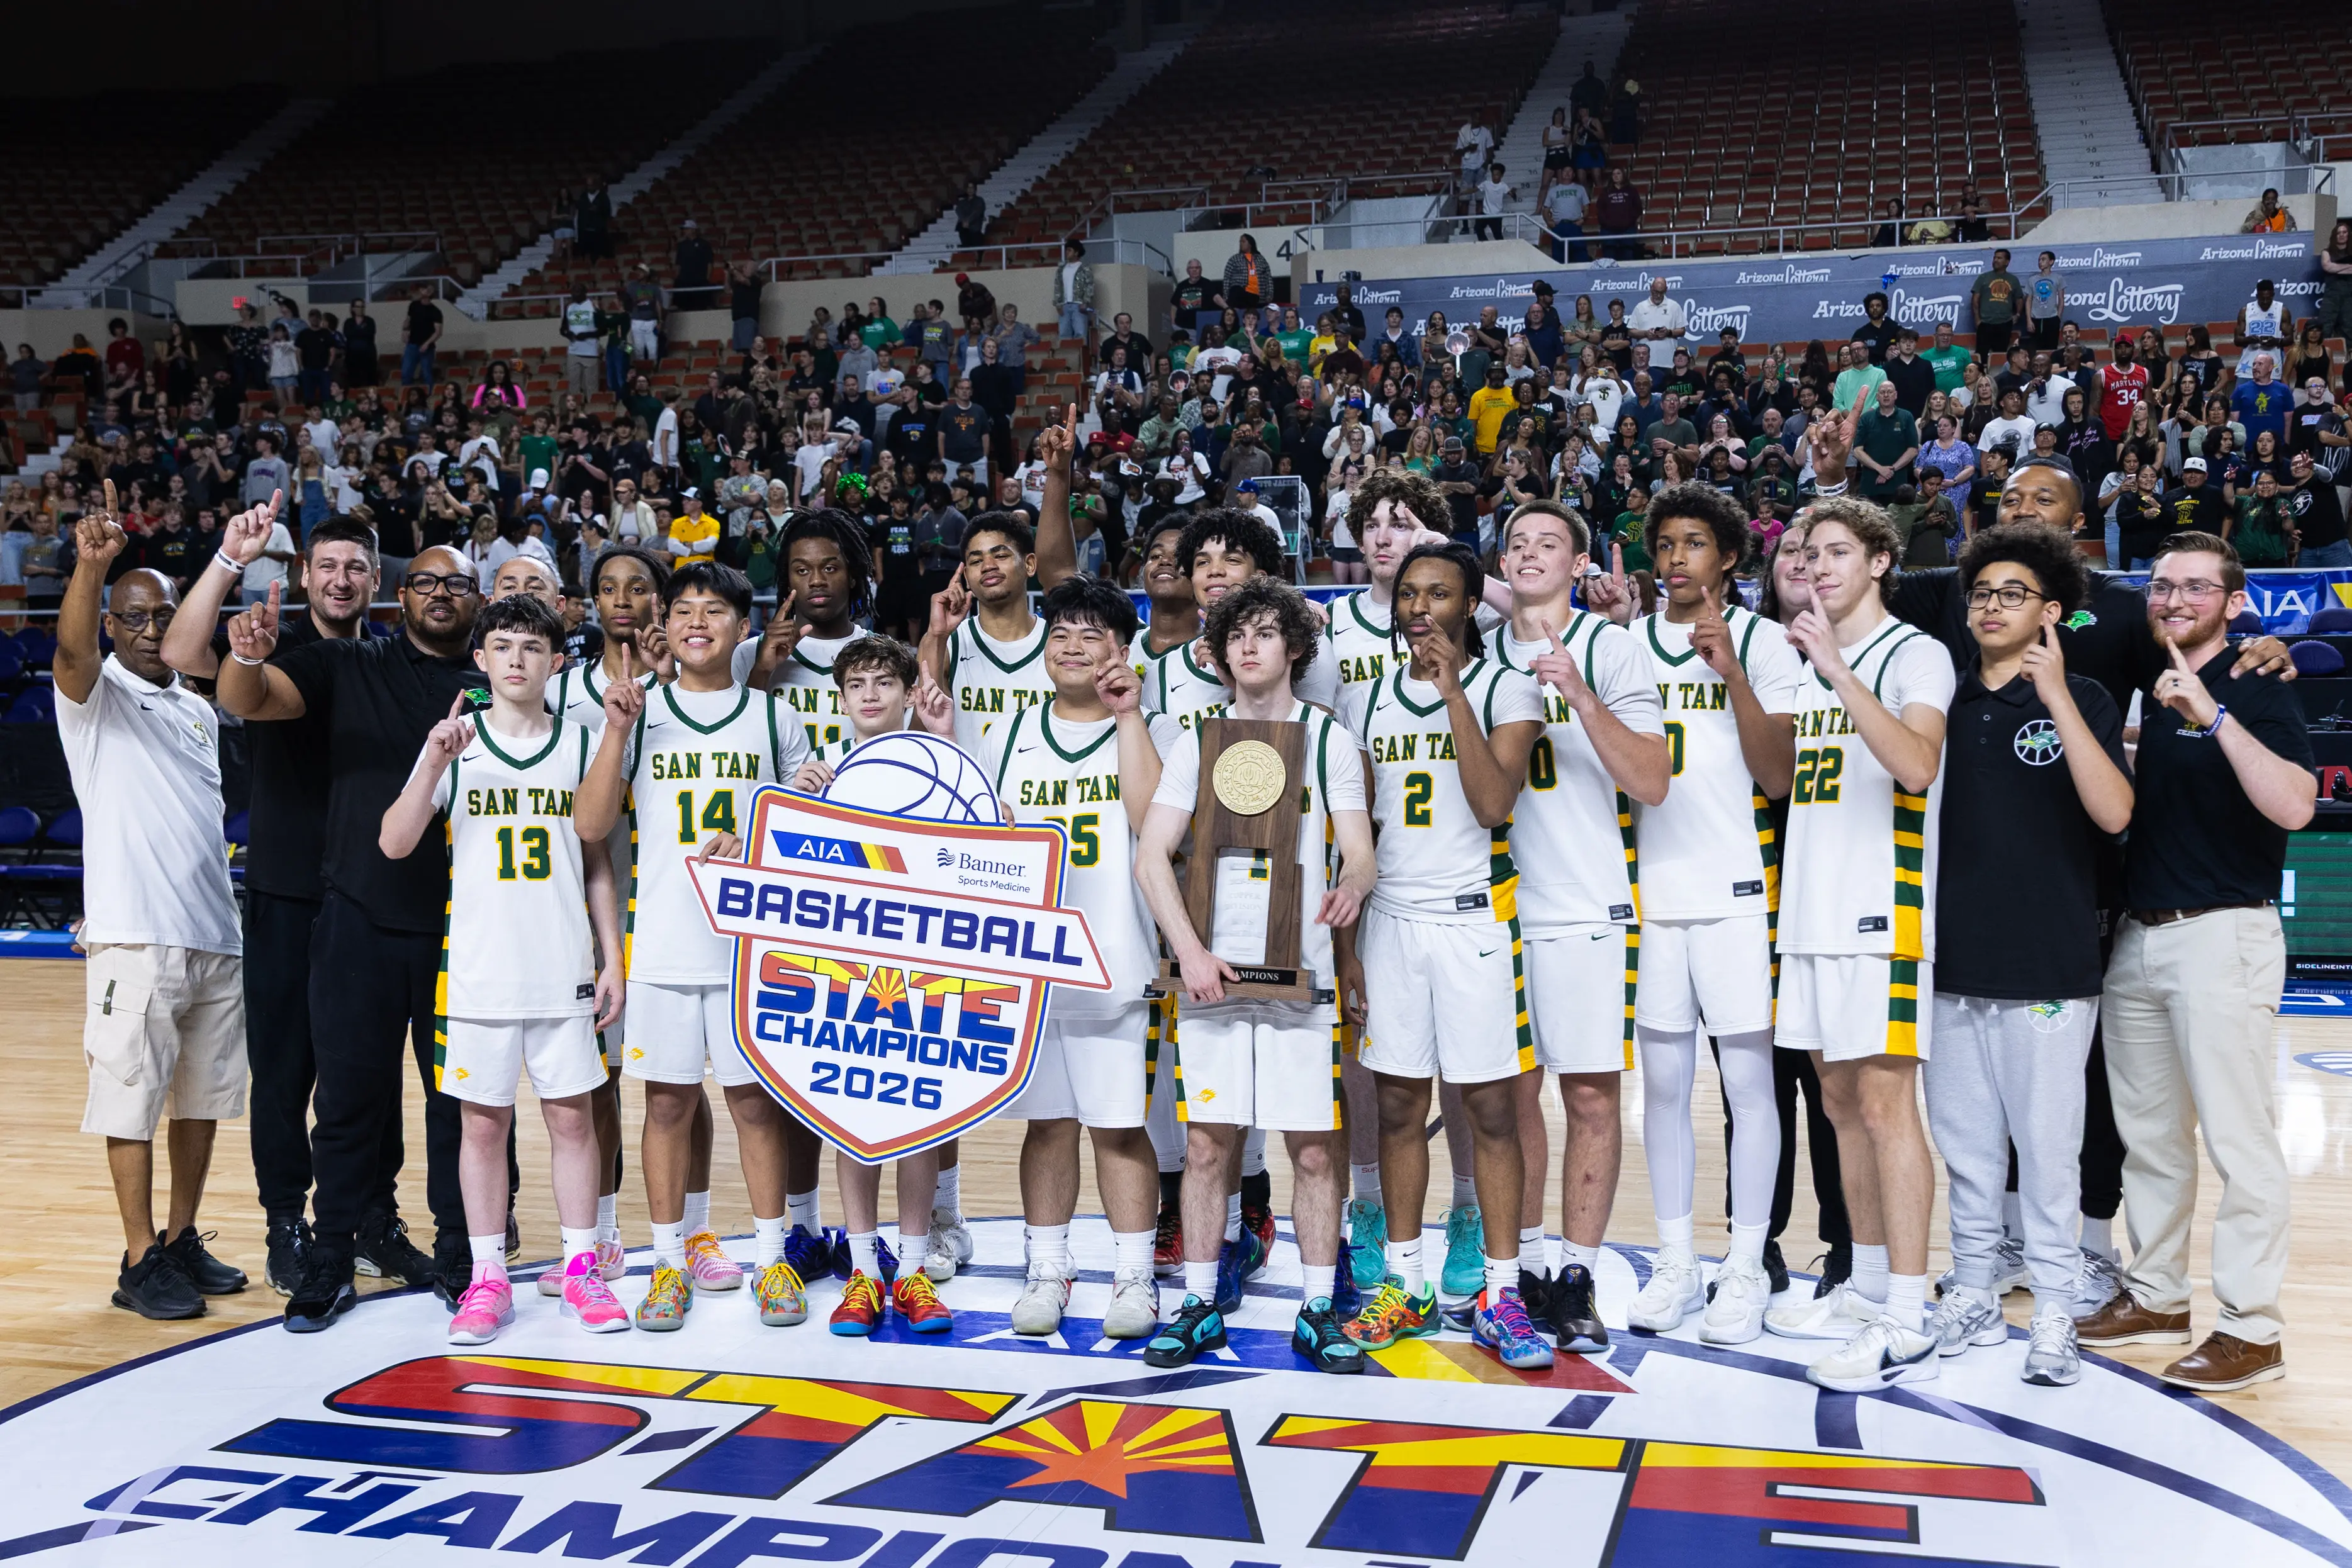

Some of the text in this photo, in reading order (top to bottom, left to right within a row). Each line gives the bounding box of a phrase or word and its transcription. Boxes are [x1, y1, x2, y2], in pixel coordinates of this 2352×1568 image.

[2052, 256, 2091, 267] rizona
[2200, 247, 2253, 260] Arizona
[1590, 279, 1637, 291] Arizona
[1735, 272, 1784, 284] Arizona
[1886, 264, 1935, 276] Arizona
[1450, 286, 1495, 299] Arizona
[2088, 277, 2184, 325] Lottery
[2249, 319, 2277, 335] 22
[2117, 390, 2139, 406] 34
[1339, 654, 1384, 684] SAN
[961, 686, 1005, 713] SAN
[1543, 695, 1571, 724] AN
[1678, 683, 1727, 710] TAN
[1372, 732, 1457, 764] SAN TA
[652, 751, 761, 781] SAN TAN
[1793, 746, 1844, 805] 22
[468, 787, 573, 819] SAN TAN
[1020, 774, 1121, 806] SAN TAN
[1403, 770, 1434, 828] 2
[676, 788, 737, 845] 14
[1226, 800, 1269, 814] ASSOCIATION
[496, 826, 553, 881] 13
[796, 839, 846, 863] AIA
[1042, 812, 1100, 868] 5
[958, 851, 1025, 878] Banner
[958, 874, 1031, 893] Sports Medicine
[717, 877, 1083, 967] BASKETBALL
[756, 950, 1021, 1046] STATE
[755, 1011, 1008, 1076] CHAMPIONS
[809, 1061, 943, 1111] 2026
[210, 1353, 2047, 1568] STATE
